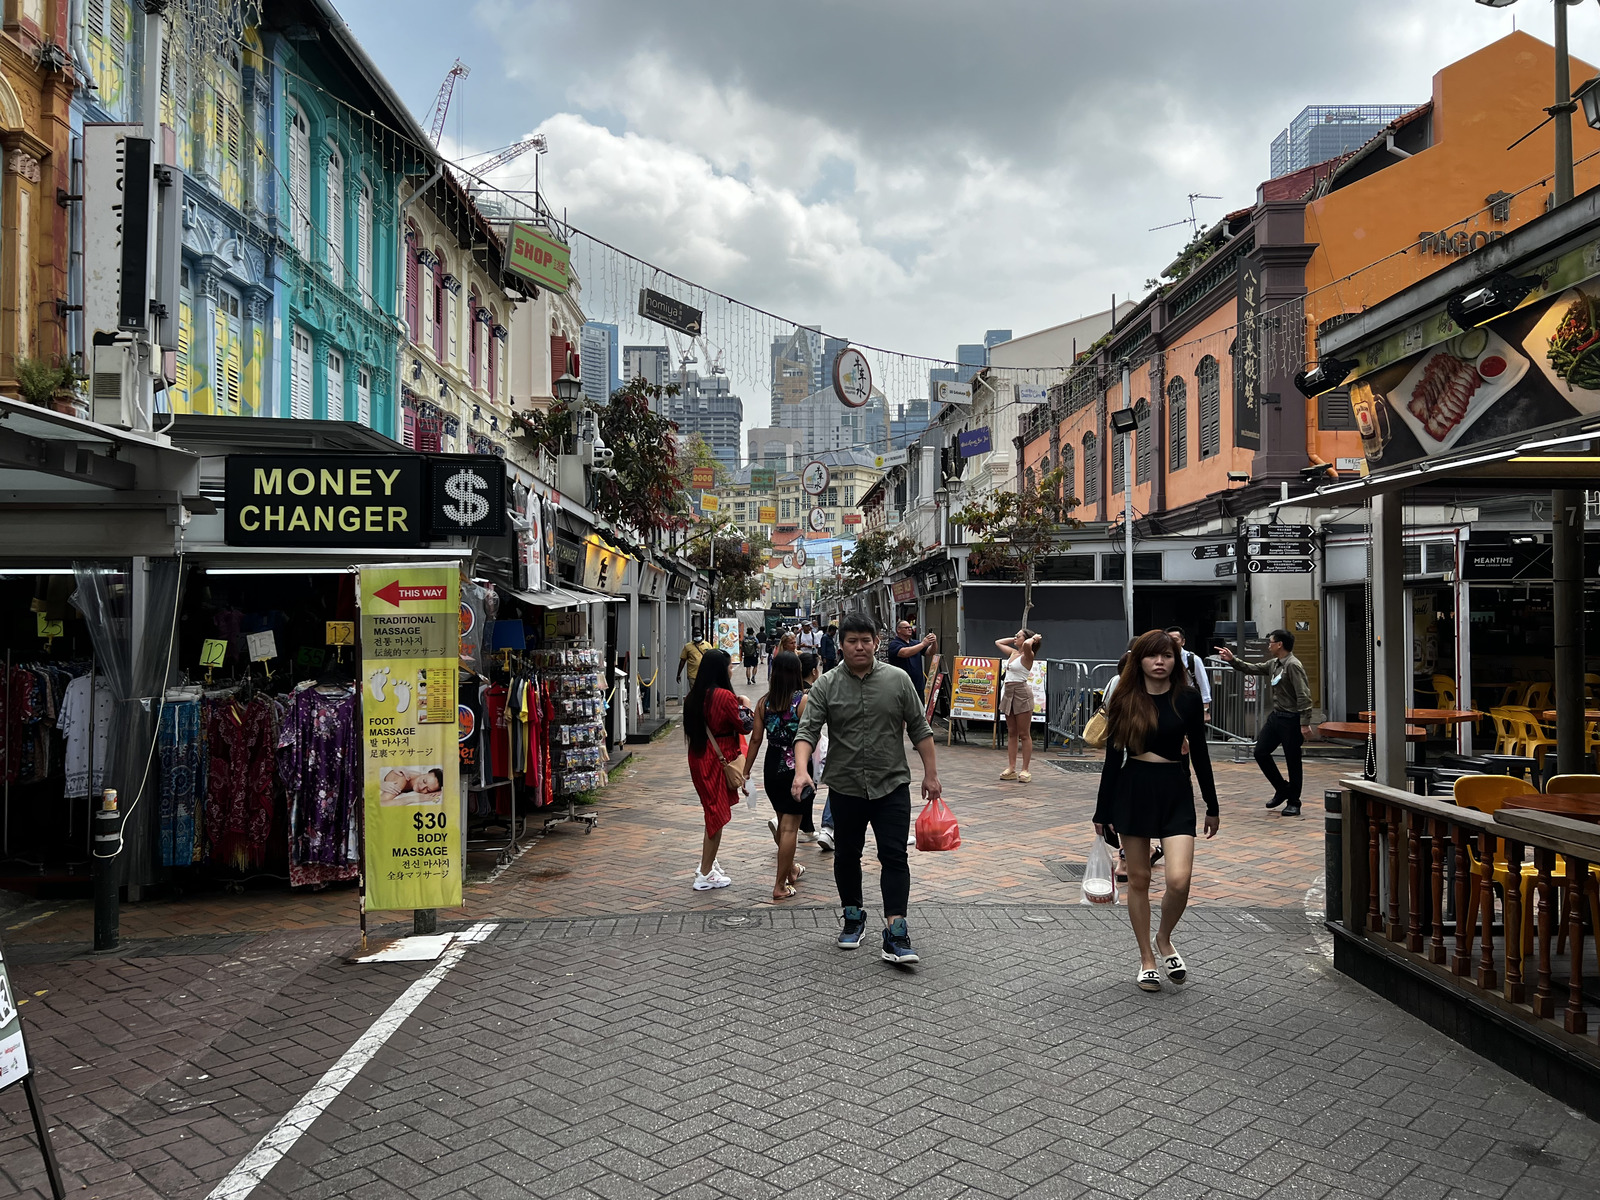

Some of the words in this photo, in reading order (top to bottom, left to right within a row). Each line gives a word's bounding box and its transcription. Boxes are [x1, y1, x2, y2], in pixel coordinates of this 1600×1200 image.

[514, 237, 553, 268] SHOP
[646, 297, 678, 317] nomiya
[253, 468, 402, 496] MONEY
[442, 468, 490, 527] $
[239, 505, 409, 532] CHANGER
[1565, 506, 1577, 527] 7
[399, 589, 420, 598] THIS
[422, 589, 443, 597] WAY
[373, 616, 436, 625] TRADITIONAL
[545, 614, 557, 636] 5
[565, 613, 580, 636] $10
[330, 626, 351, 645] 12
[373, 627, 421, 636] MASSAGE
[374, 637, 392, 647] 전통
[395, 636, 423, 647] 마사지
[202, 642, 225, 664] 12
[374, 647, 447, 657] 伝統的マッサージ
[369, 717, 395, 726] FOOT
[369, 727, 416, 736] MASSAGE
[369, 738, 378, 748] 발
[382, 737, 410, 747] 마사지
[369, 747, 434, 759] 足裏マッサージ
[412, 811, 447, 830] $30
[417, 833, 448, 843] BODY
[392, 847, 448, 857] MASSAGE
[401, 860, 421, 870] 전신
[423, 858, 450, 868] 마사지
[386, 870, 450, 881] 全身マッサージ
